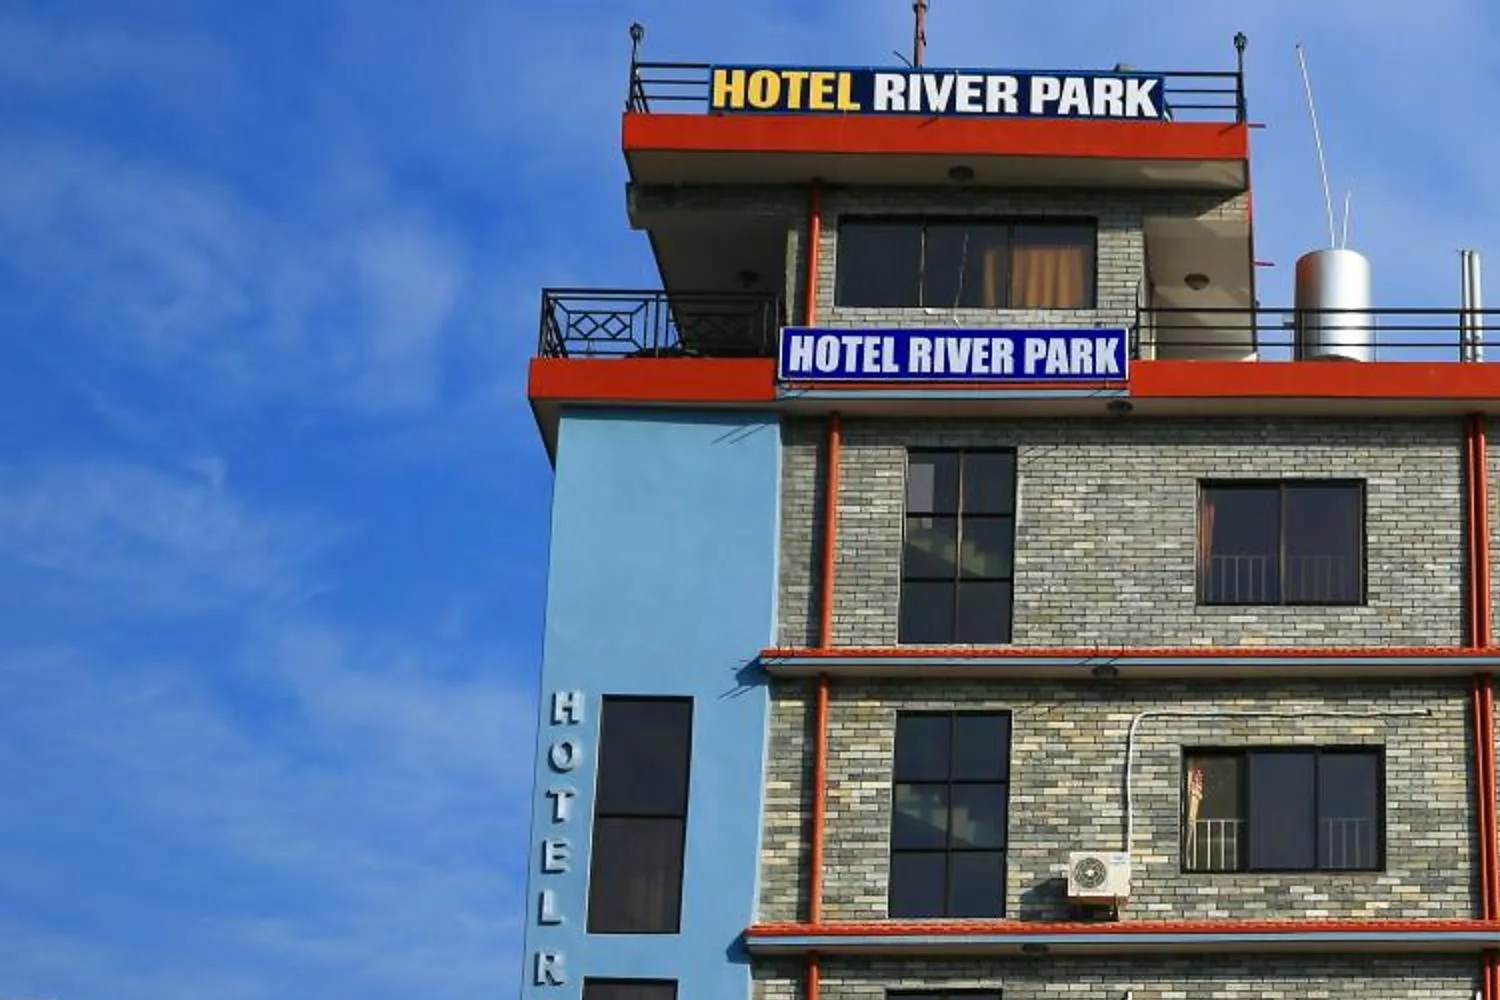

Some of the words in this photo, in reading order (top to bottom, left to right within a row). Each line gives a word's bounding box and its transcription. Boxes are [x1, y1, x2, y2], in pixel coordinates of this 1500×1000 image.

[712, 69, 860, 111] HOTEL
[874, 73, 1018, 113] RIVER
[1029, 76, 1158, 118] PARK
[789, 335, 899, 373] HOTEL
[909, 337, 1015, 374] RIVER
[1024, 338, 1121, 375] PARK
[538, 689, 585, 926] HOTEL
